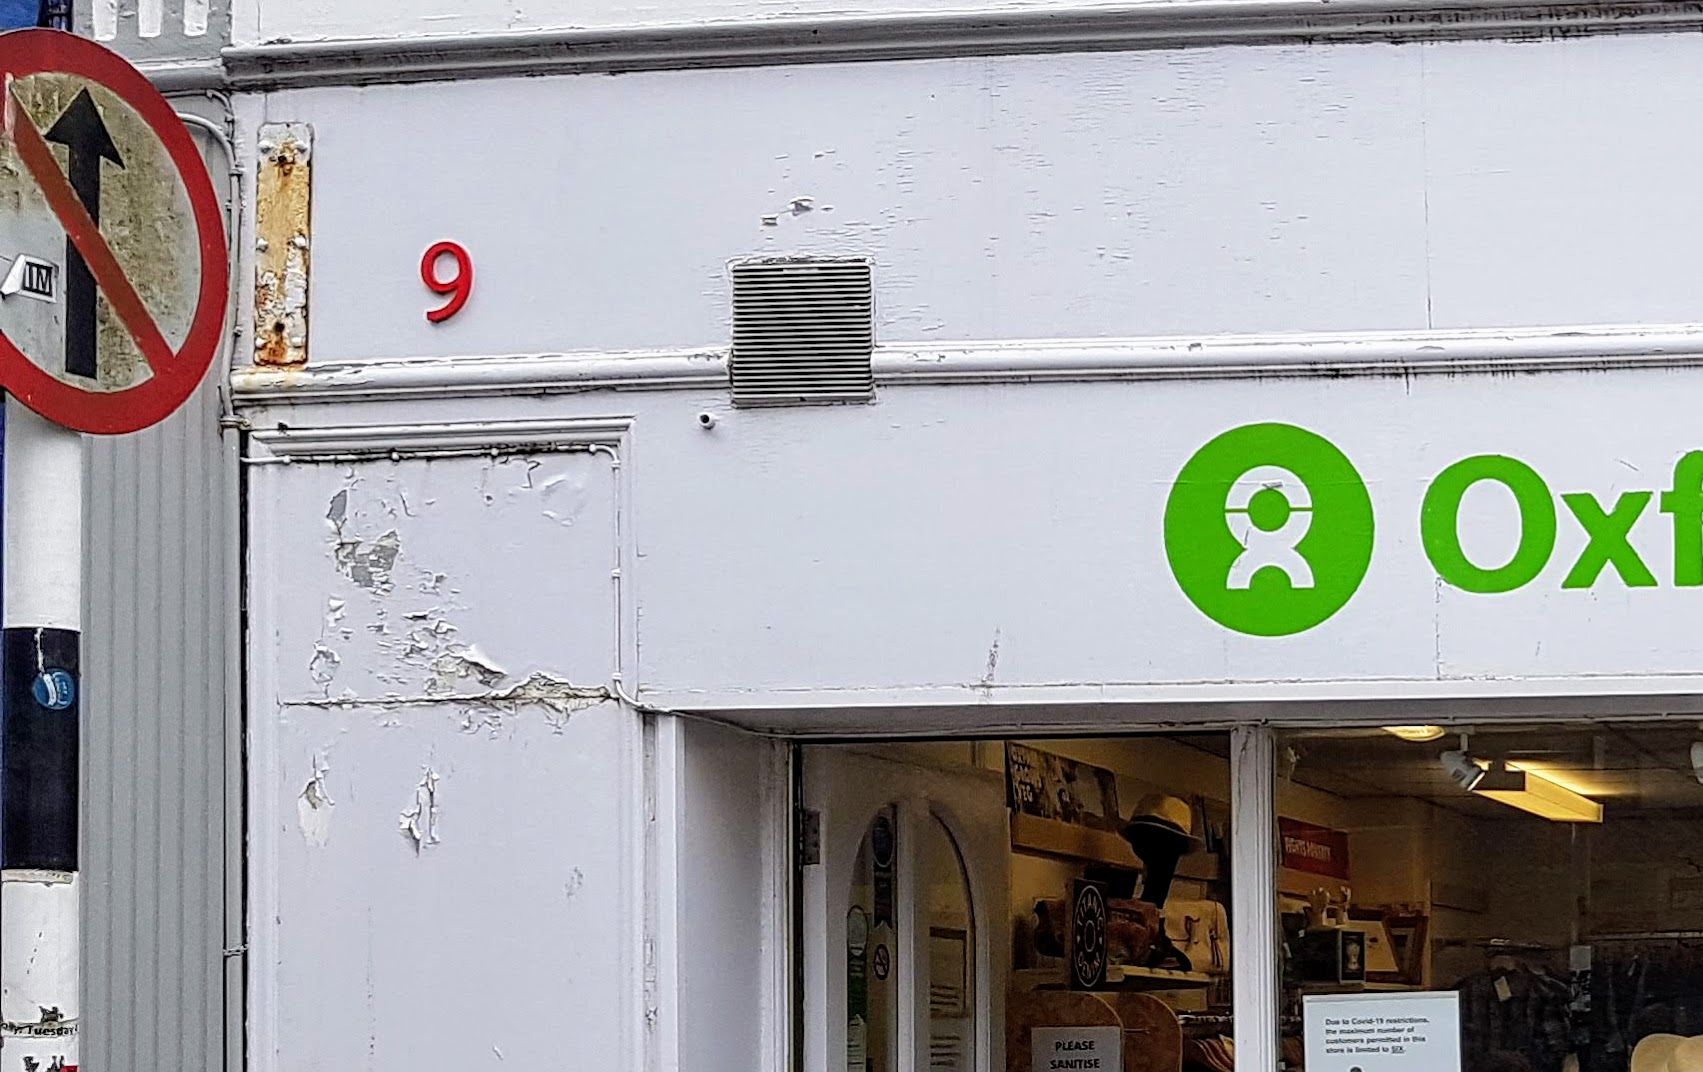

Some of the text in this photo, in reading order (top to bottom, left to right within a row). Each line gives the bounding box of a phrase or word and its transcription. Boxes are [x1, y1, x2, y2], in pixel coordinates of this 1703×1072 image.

[421, 241, 473, 324] 9
[1055, 1041, 1095, 1051] PLEASE
[1050, 1058, 1100, 1069] SANITISE
